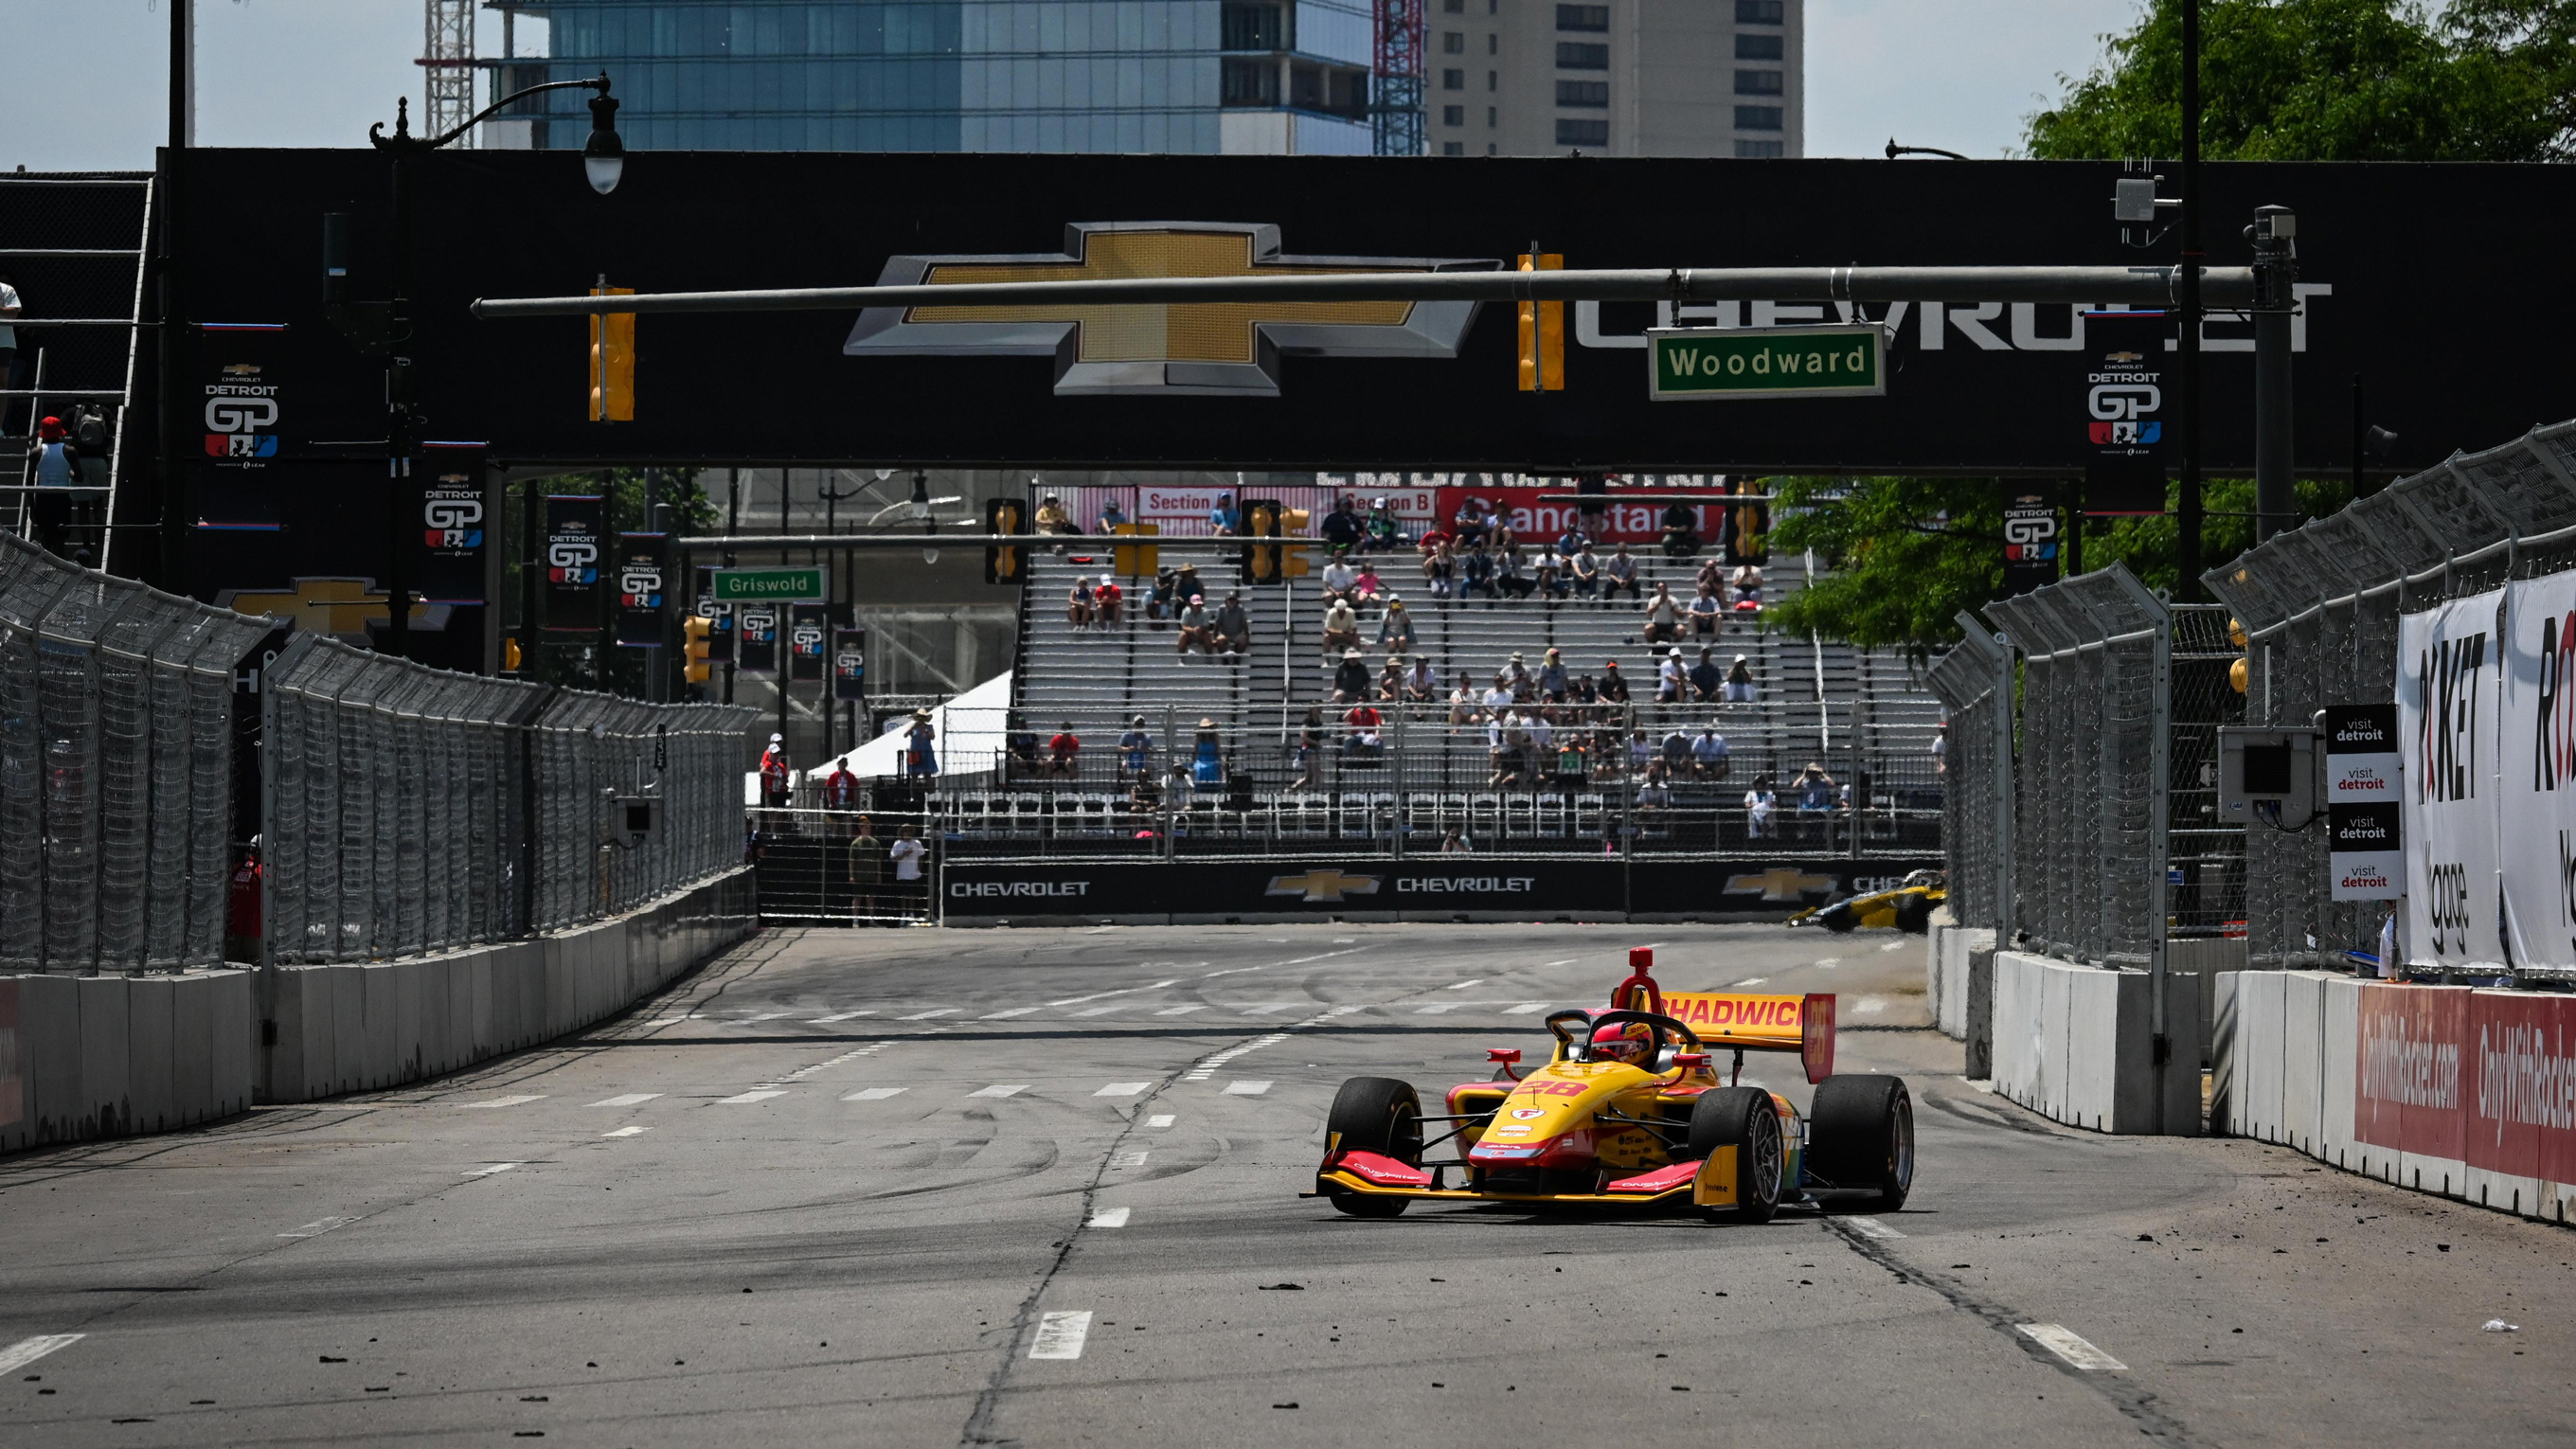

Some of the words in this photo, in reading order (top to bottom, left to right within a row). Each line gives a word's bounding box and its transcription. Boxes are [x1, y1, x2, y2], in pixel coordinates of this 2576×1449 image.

[1669, 346, 1865, 376] Woodward
[2088, 373, 2160, 383] DETROIT
[206, 385, 278, 396] DETROIT
[2088, 385, 2160, 420] GP
[205, 397, 278, 433] GP
[425, 490, 482, 499] DETROIT
[1150, 492, 1210, 510] Section
[1346, 492, 1411, 511] Secon
[1417, 494, 1429, 510] B
[424, 500, 483, 528] GP
[2004, 509, 2055, 518] DETROIT
[2005, 517, 2055, 544] GP
[549, 543, 598, 567] GP
[621, 565, 662, 574] DETROIT
[621, 573, 662, 594] GP
[729, 576, 807, 592] Griswold
[742, 615, 775, 631] GP
[794, 631, 822, 644] GP
[837, 653, 864, 668] GP
[2347, 718, 2372, 730] visit
[2336, 728, 2384, 742] detroit
[2349, 767, 2373, 778] visit
[2338, 778, 2385, 791] detroit
[2350, 815, 2375, 828] visit
[2339, 827, 2386, 839] detroit
[2351, 865, 2376, 877] visit
[1396, 877, 1535, 892] CHEVROLET
[2341, 876, 2388, 888] detroit
[950, 882, 1090, 898] CHEVROLET
[1650, 999, 1804, 1027] HADWIC
[1512, 1080, 1590, 1097] 28
[2478, 1020, 2576, 1148] OnlyWithRocke
